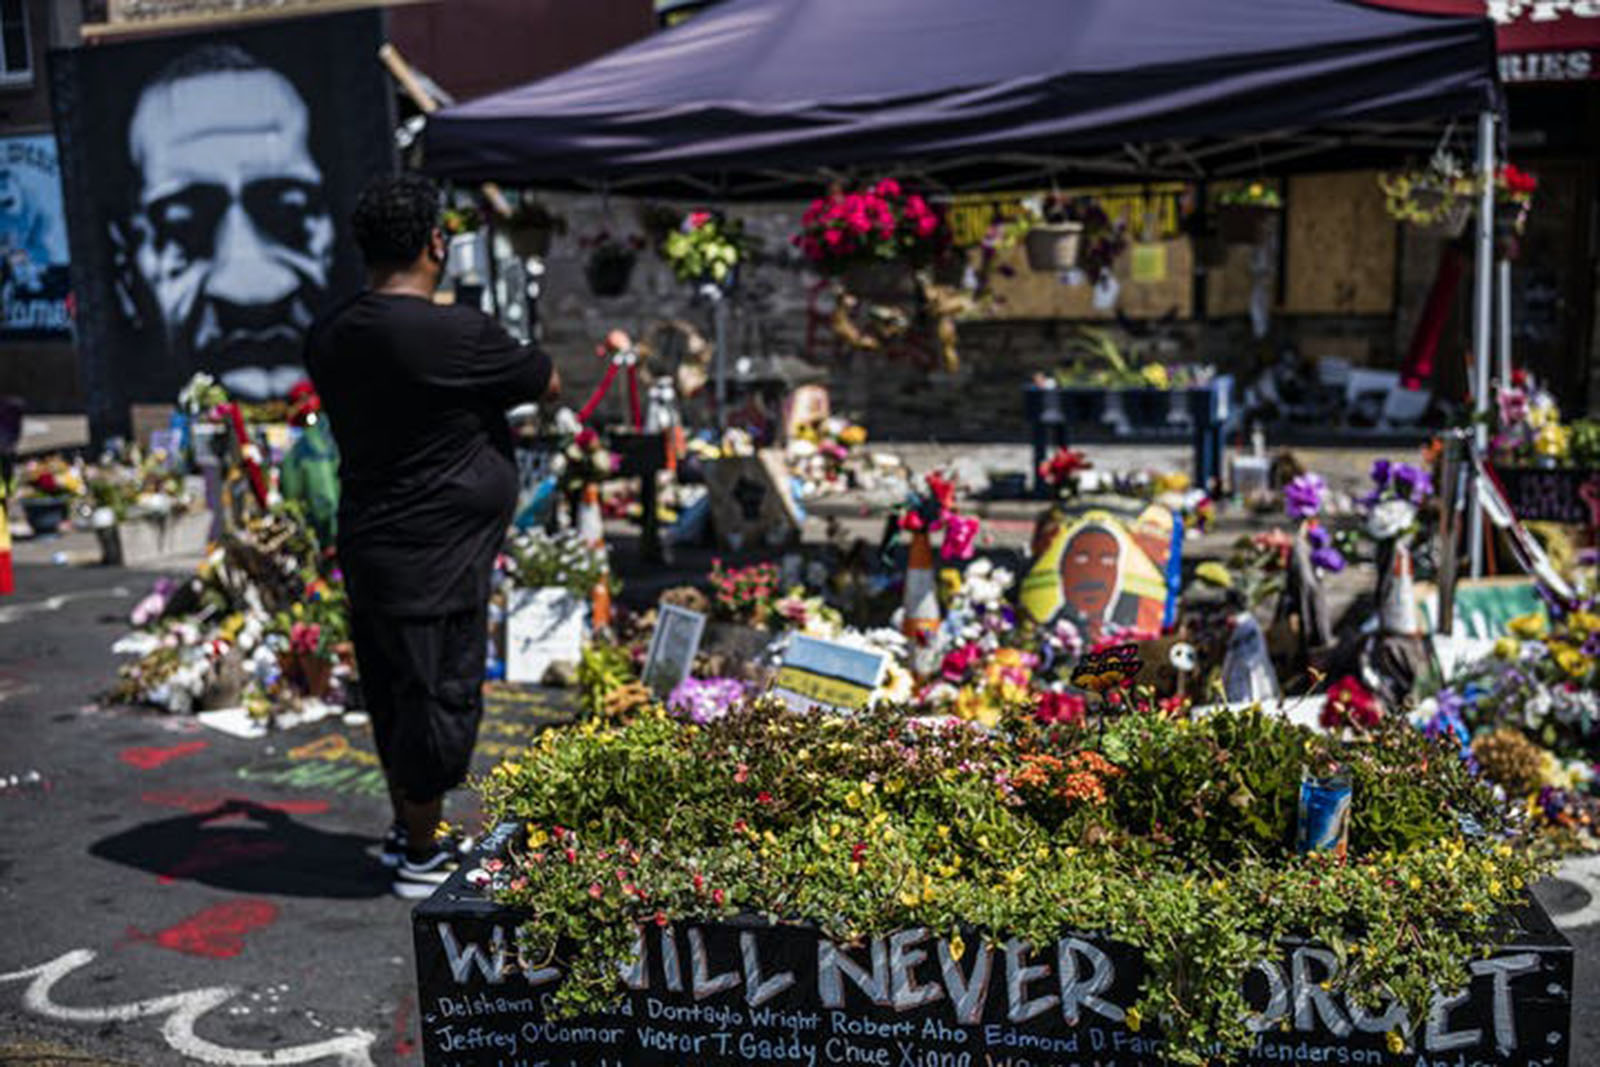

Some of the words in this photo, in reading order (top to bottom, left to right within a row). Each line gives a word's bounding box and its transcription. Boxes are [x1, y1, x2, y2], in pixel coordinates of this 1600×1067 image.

[818, 926, 1126, 1027] NEVER
[435, 1026, 517, 1055] Jeffrey
[521, 1021, 625, 1045] O'Connor
[637, 1026, 706, 1054] Victor
[710, 1032, 733, 1056] T.
[739, 1032, 817, 1067] Gaddy
[826, 1037, 890, 1066] Chue
[748, 1006, 821, 1039] Wright
[831, 1011, 915, 1038] Robert
[921, 1017, 968, 1043] Aho
[984, 1024, 1079, 1052] Edmond
